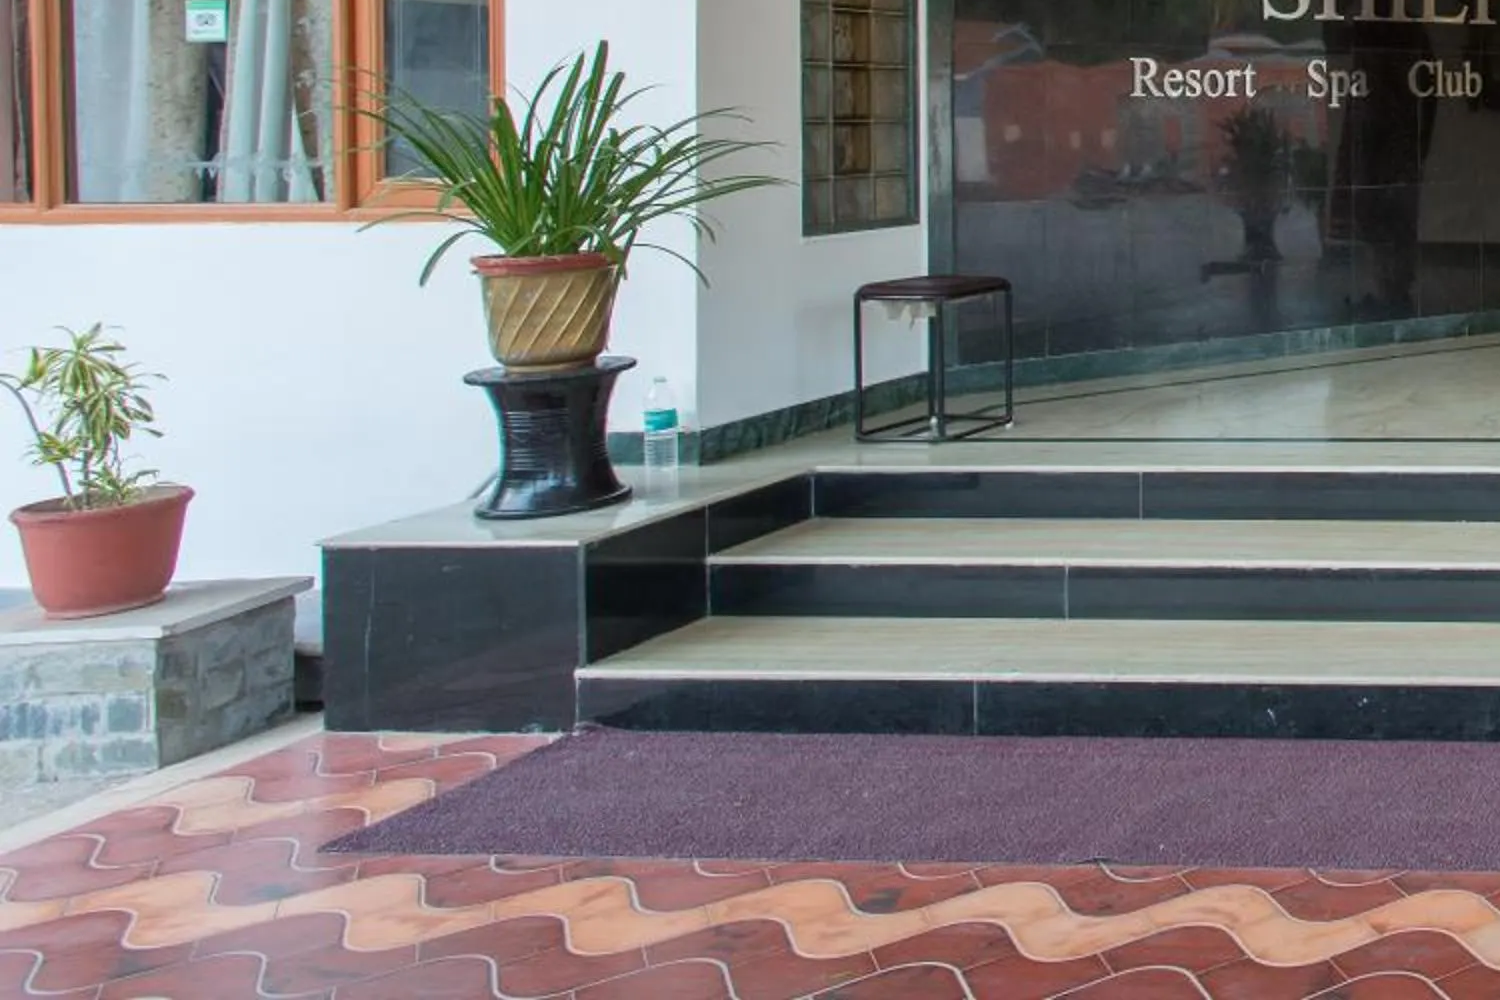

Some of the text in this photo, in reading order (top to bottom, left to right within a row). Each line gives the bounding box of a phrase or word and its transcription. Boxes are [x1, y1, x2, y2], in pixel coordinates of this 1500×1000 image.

[1129, 57, 1483, 108] Resort Spa Club
